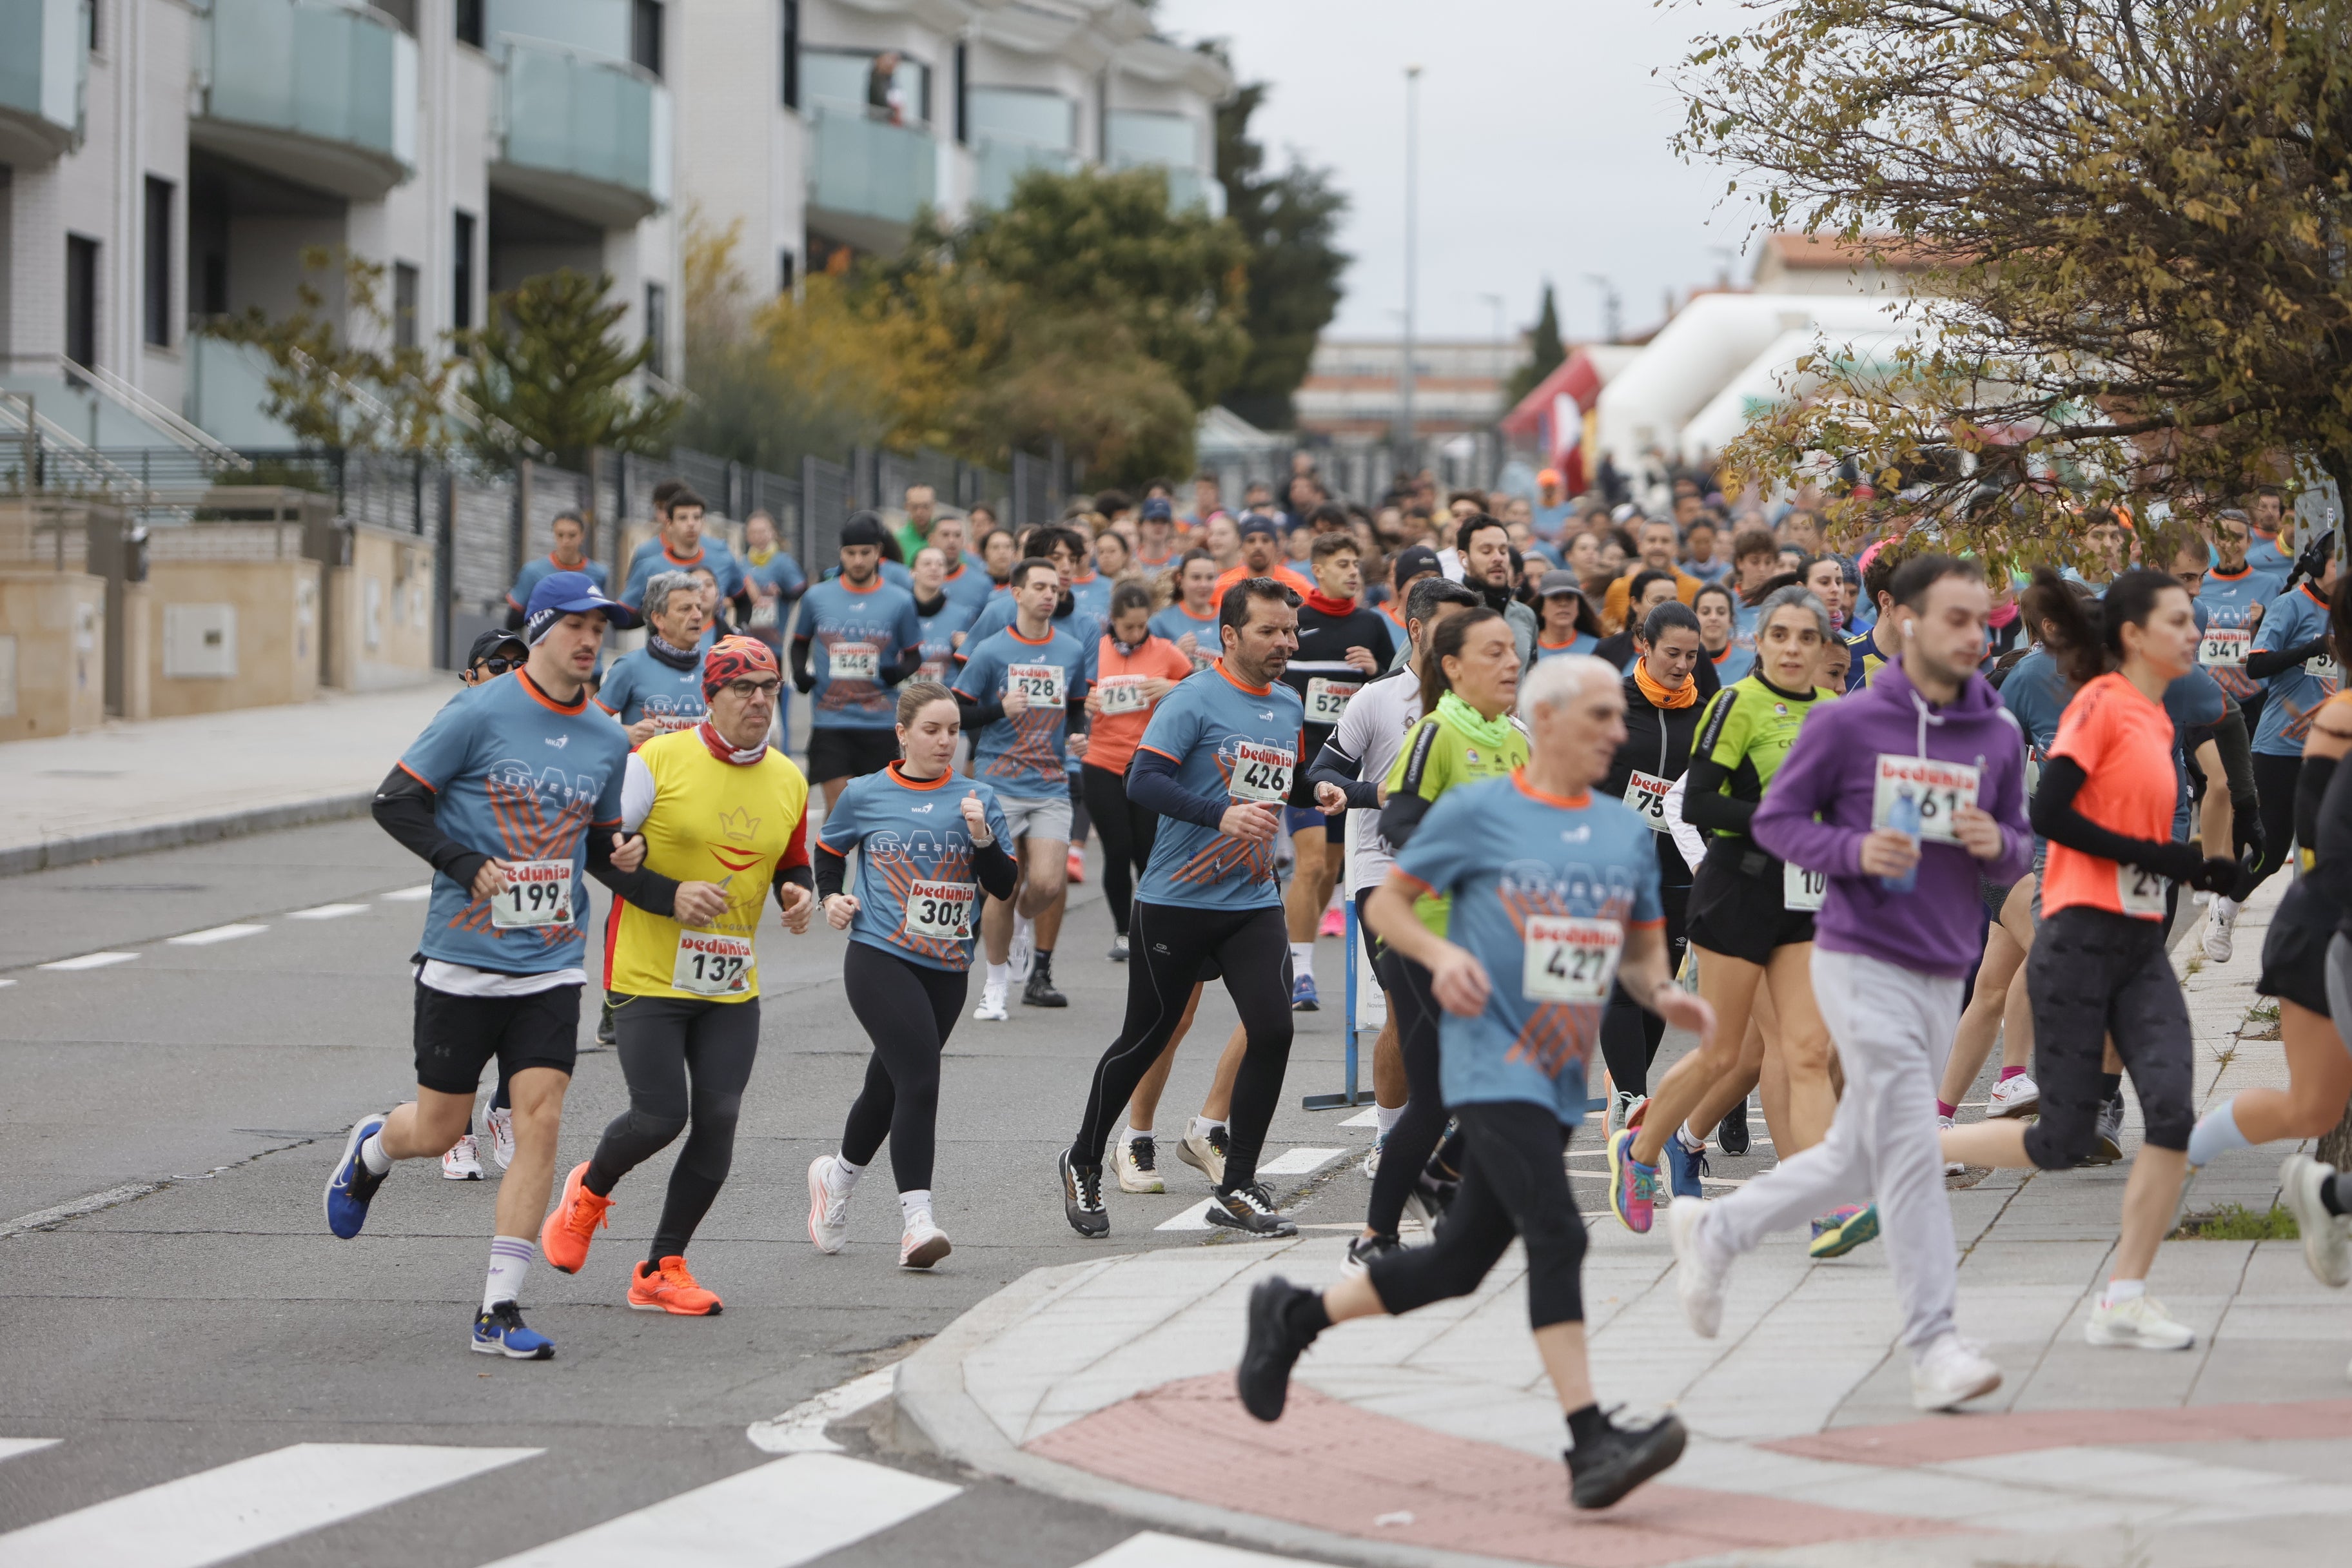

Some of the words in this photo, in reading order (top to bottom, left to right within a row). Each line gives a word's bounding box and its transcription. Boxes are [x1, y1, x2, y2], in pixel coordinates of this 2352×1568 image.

[2208, 641, 2240, 656] 341
[1019, 678, 1054, 696] 528
[1104, 685, 1137, 704] 761
[545, 738, 560, 747] MKA
[1240, 745, 1292, 768] bedunia
[1244, 763, 1284, 791] 426
[1883, 762, 1975, 790] bedunia
[504, 865, 570, 882] edunia
[509, 882, 559, 912] 199
[912, 883, 973, 901] bedunia
[919, 899, 963, 926] 303
[692, 954, 743, 981] 137
[1545, 947, 1605, 980] 427
